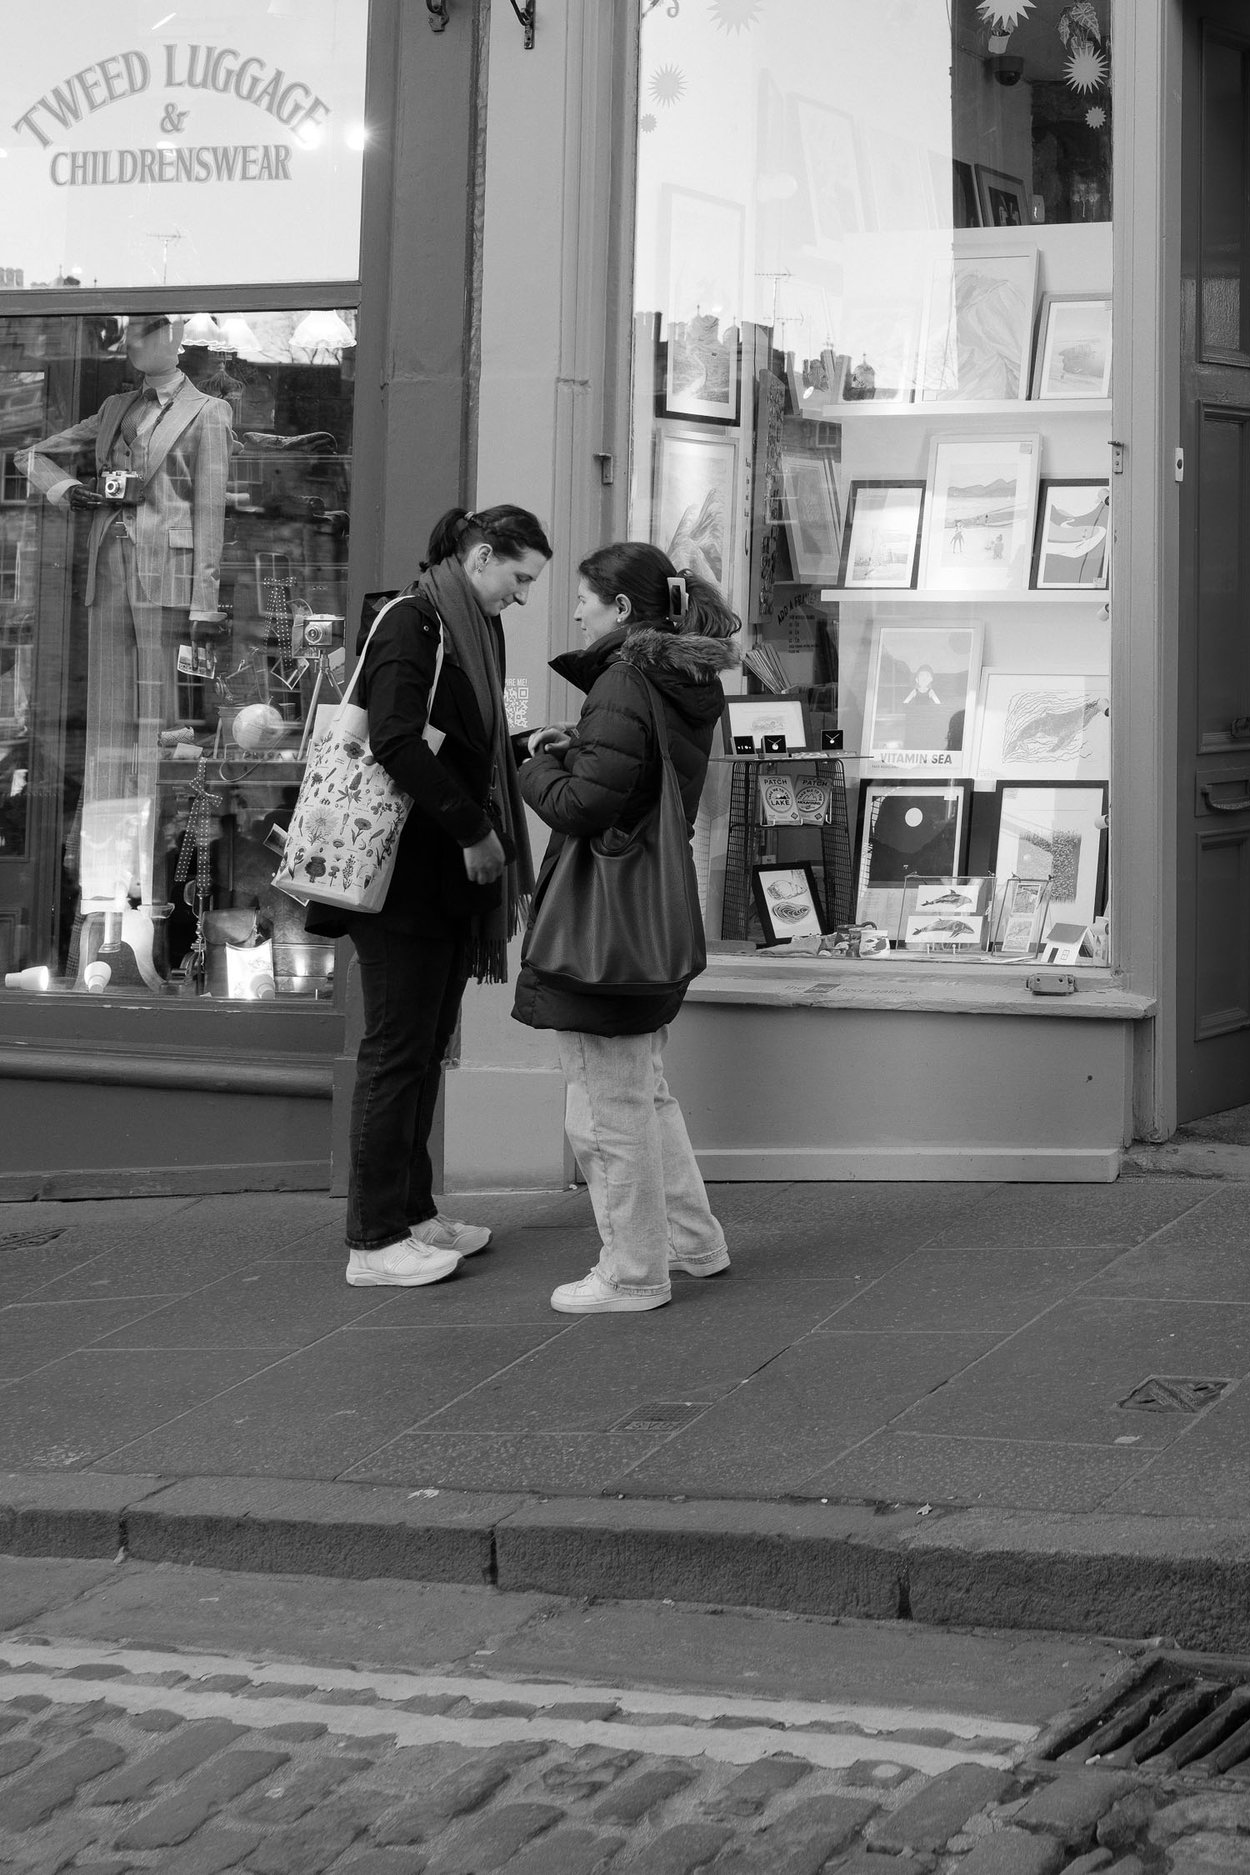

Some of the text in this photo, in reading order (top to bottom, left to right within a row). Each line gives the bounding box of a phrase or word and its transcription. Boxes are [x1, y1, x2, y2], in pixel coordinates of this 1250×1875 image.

[11, 43, 331, 149] TWEED LUGGAGE
[160, 102, 190, 134] &
[50, 143, 292, 186] CHILDRENSWEAR
[881, 753, 952, 764] VITAMIN SEA
